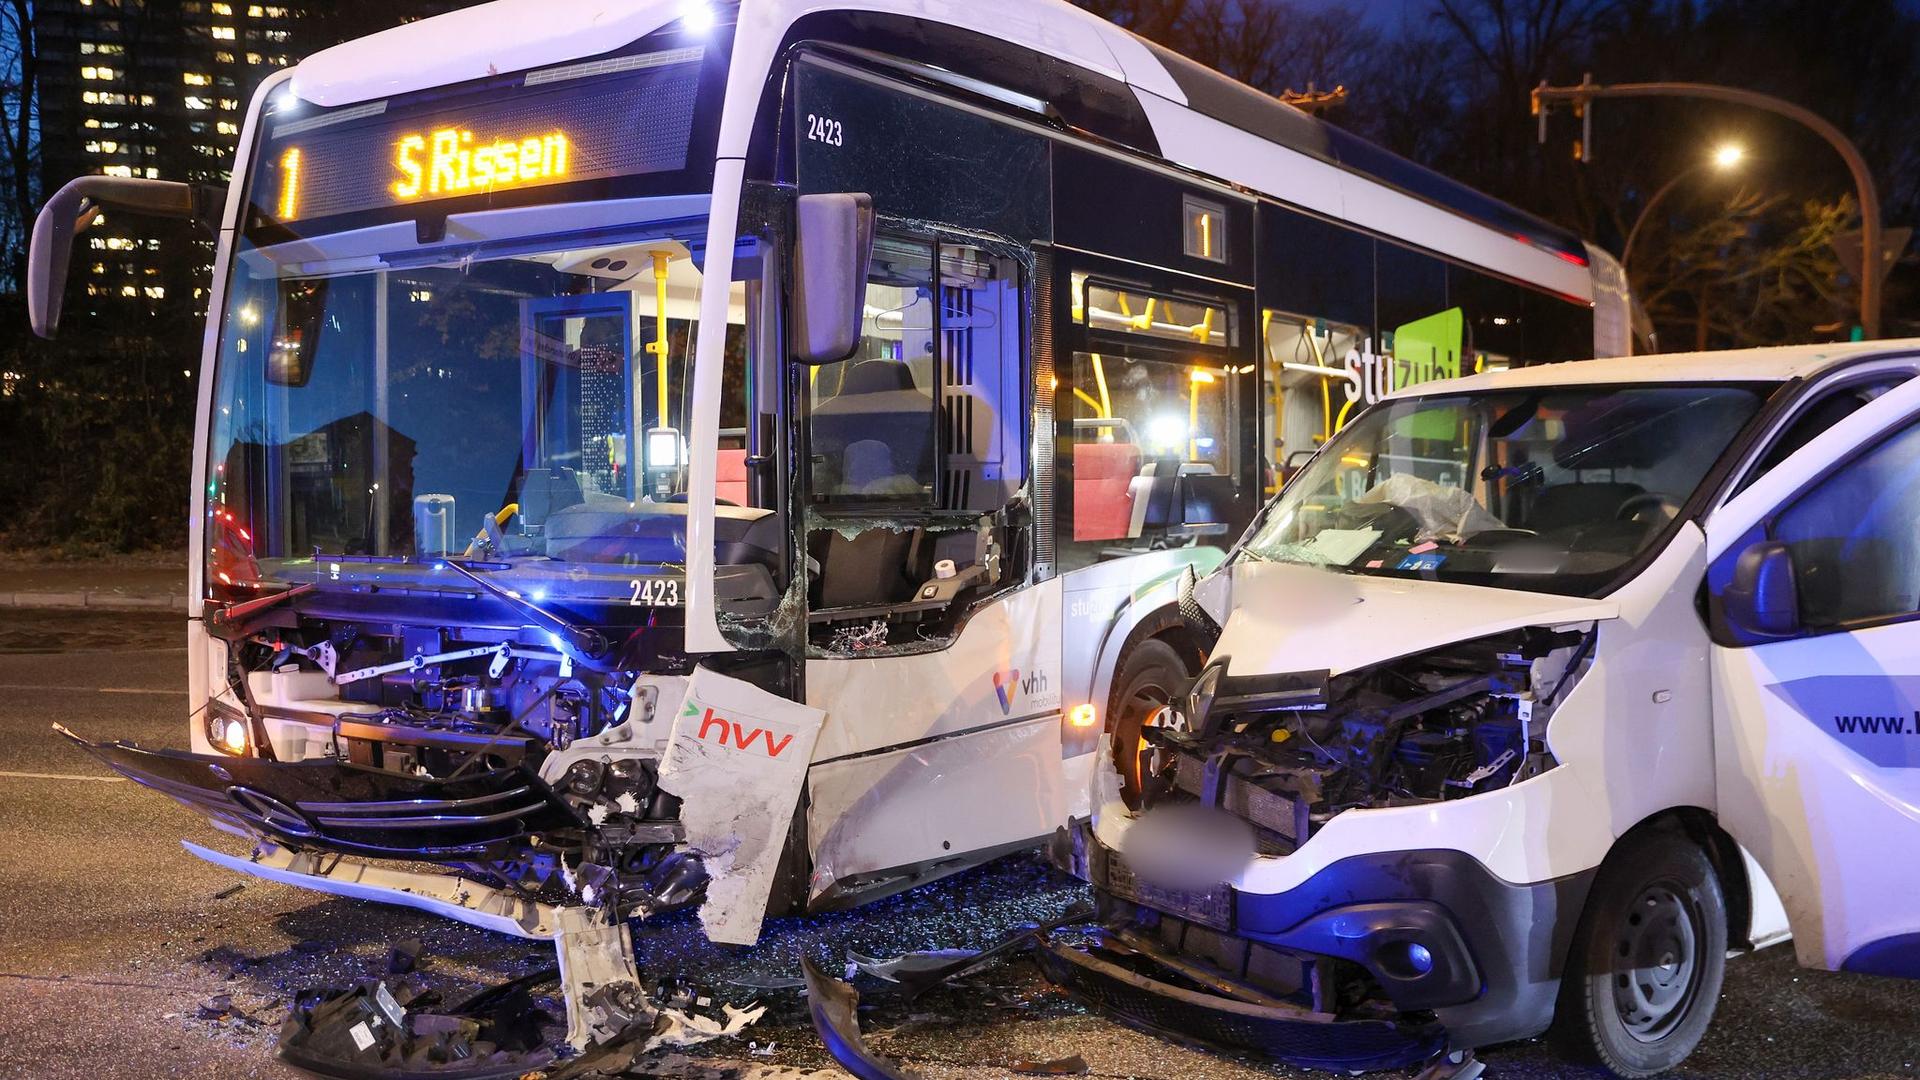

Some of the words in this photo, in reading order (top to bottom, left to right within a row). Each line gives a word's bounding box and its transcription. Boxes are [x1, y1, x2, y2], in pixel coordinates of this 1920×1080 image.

[807, 113, 843, 147] 2423
[278, 147, 301, 219] 1
[428, 127, 570, 194] Rissen
[1200, 213, 1212, 257] 1
[629, 579, 679, 607] 2423
[1022, 669, 1048, 696] vhh
[698, 707, 794, 757] hvv
